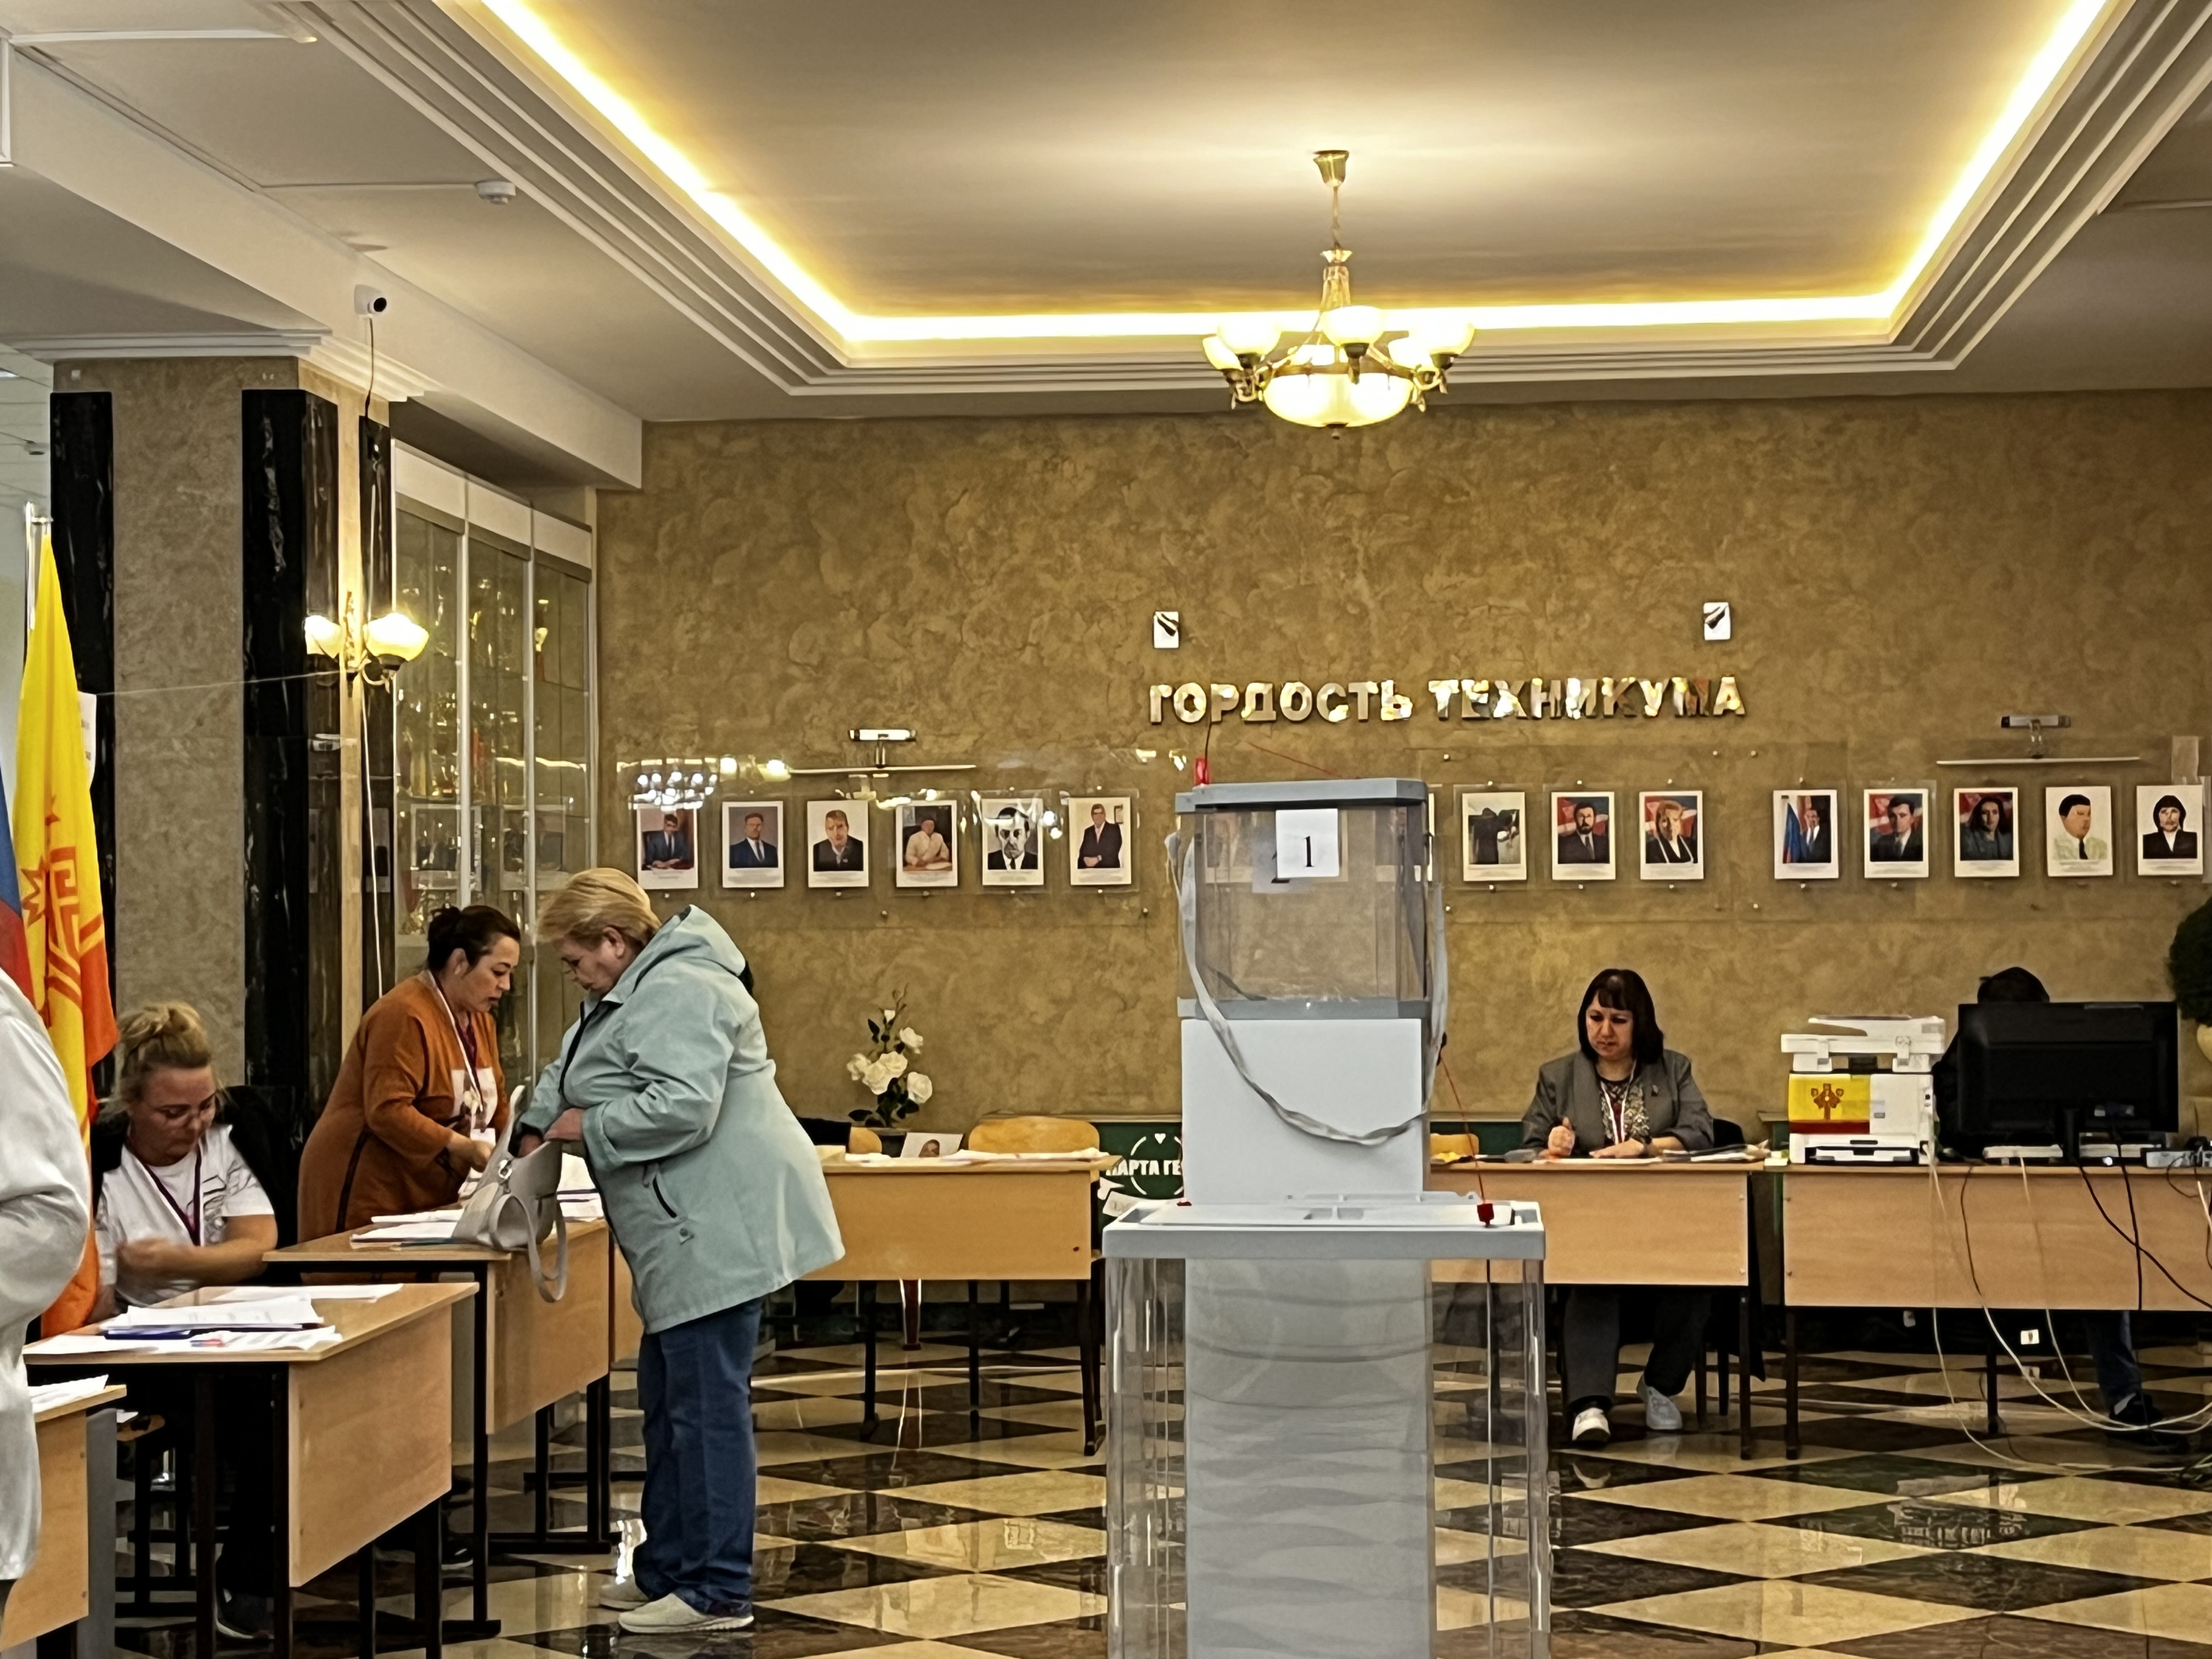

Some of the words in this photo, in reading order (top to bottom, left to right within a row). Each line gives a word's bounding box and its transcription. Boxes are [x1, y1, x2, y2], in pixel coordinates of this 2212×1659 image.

[1149, 679, 1413, 724] ГОРДОСТЬ
[1427, 675, 1746, 720] ТЕХНИКУМА
[1303, 836, 1315, 867] 1
[1163, 1159, 1182, 1176] ГЕ
